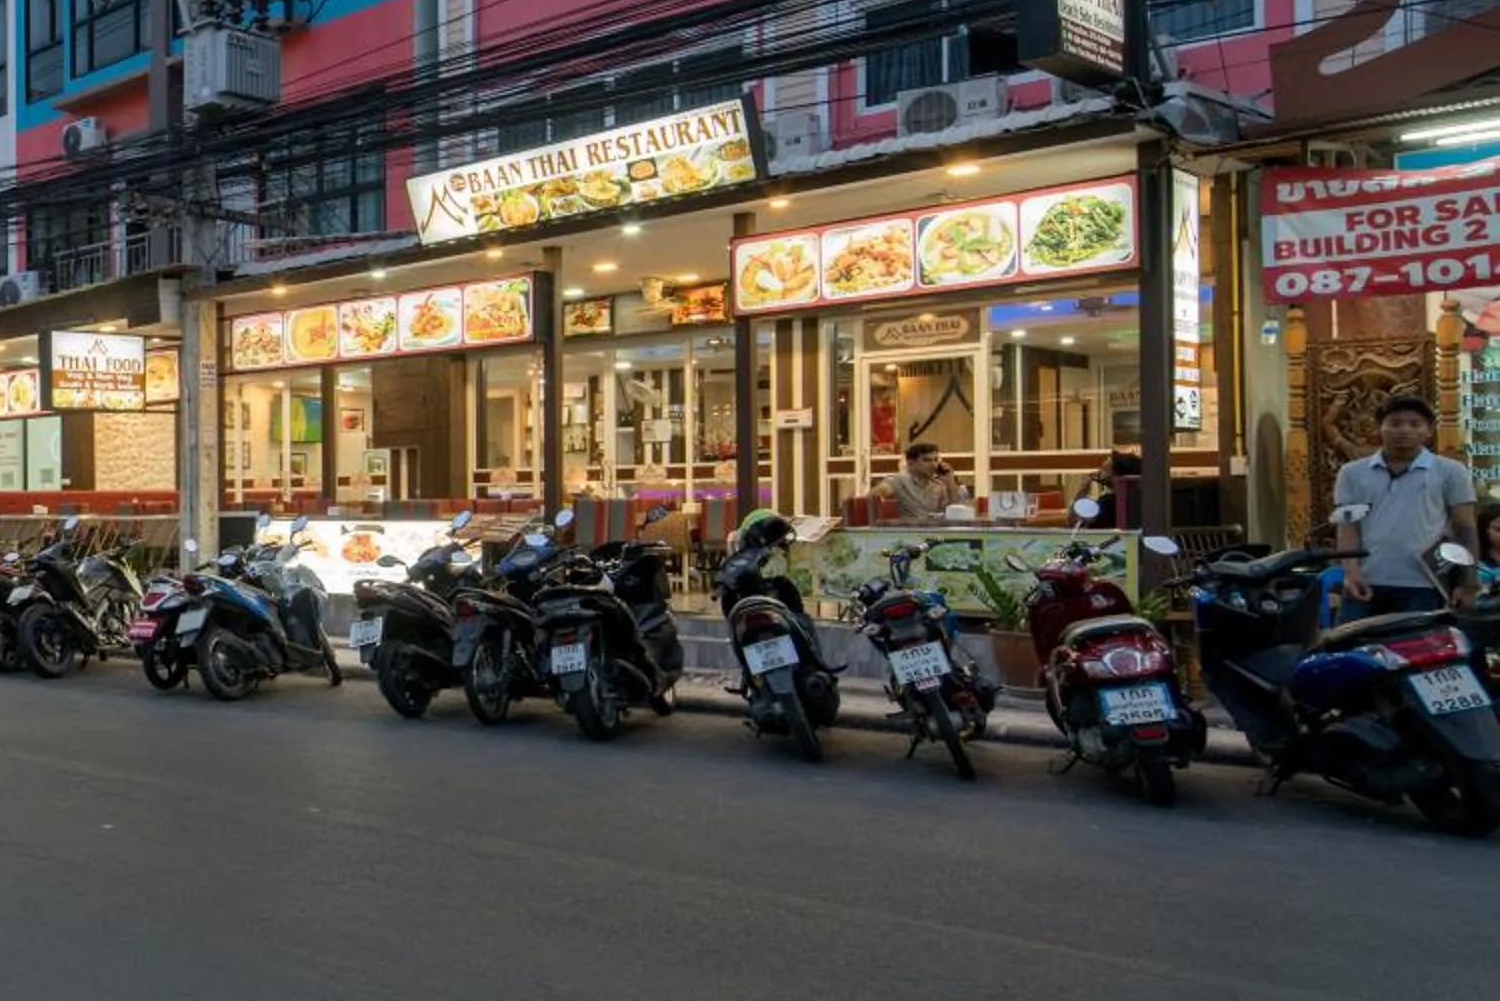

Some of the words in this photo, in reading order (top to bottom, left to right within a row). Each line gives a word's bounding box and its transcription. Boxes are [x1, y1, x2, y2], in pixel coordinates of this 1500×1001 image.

[467, 160, 521, 194] BAAN
[526, 146, 580, 181] THAI
[586, 108, 742, 166] RESTAURANT
[1345, 205, 1421, 232] FOR
[1273, 224, 1450, 261] BUILDING
[1464, 219, 1489, 241] 2
[1275, 253, 1500, 297] 087-101
[57, 354, 97, 370] THAI
[105, 356, 141, 372] FOOD
